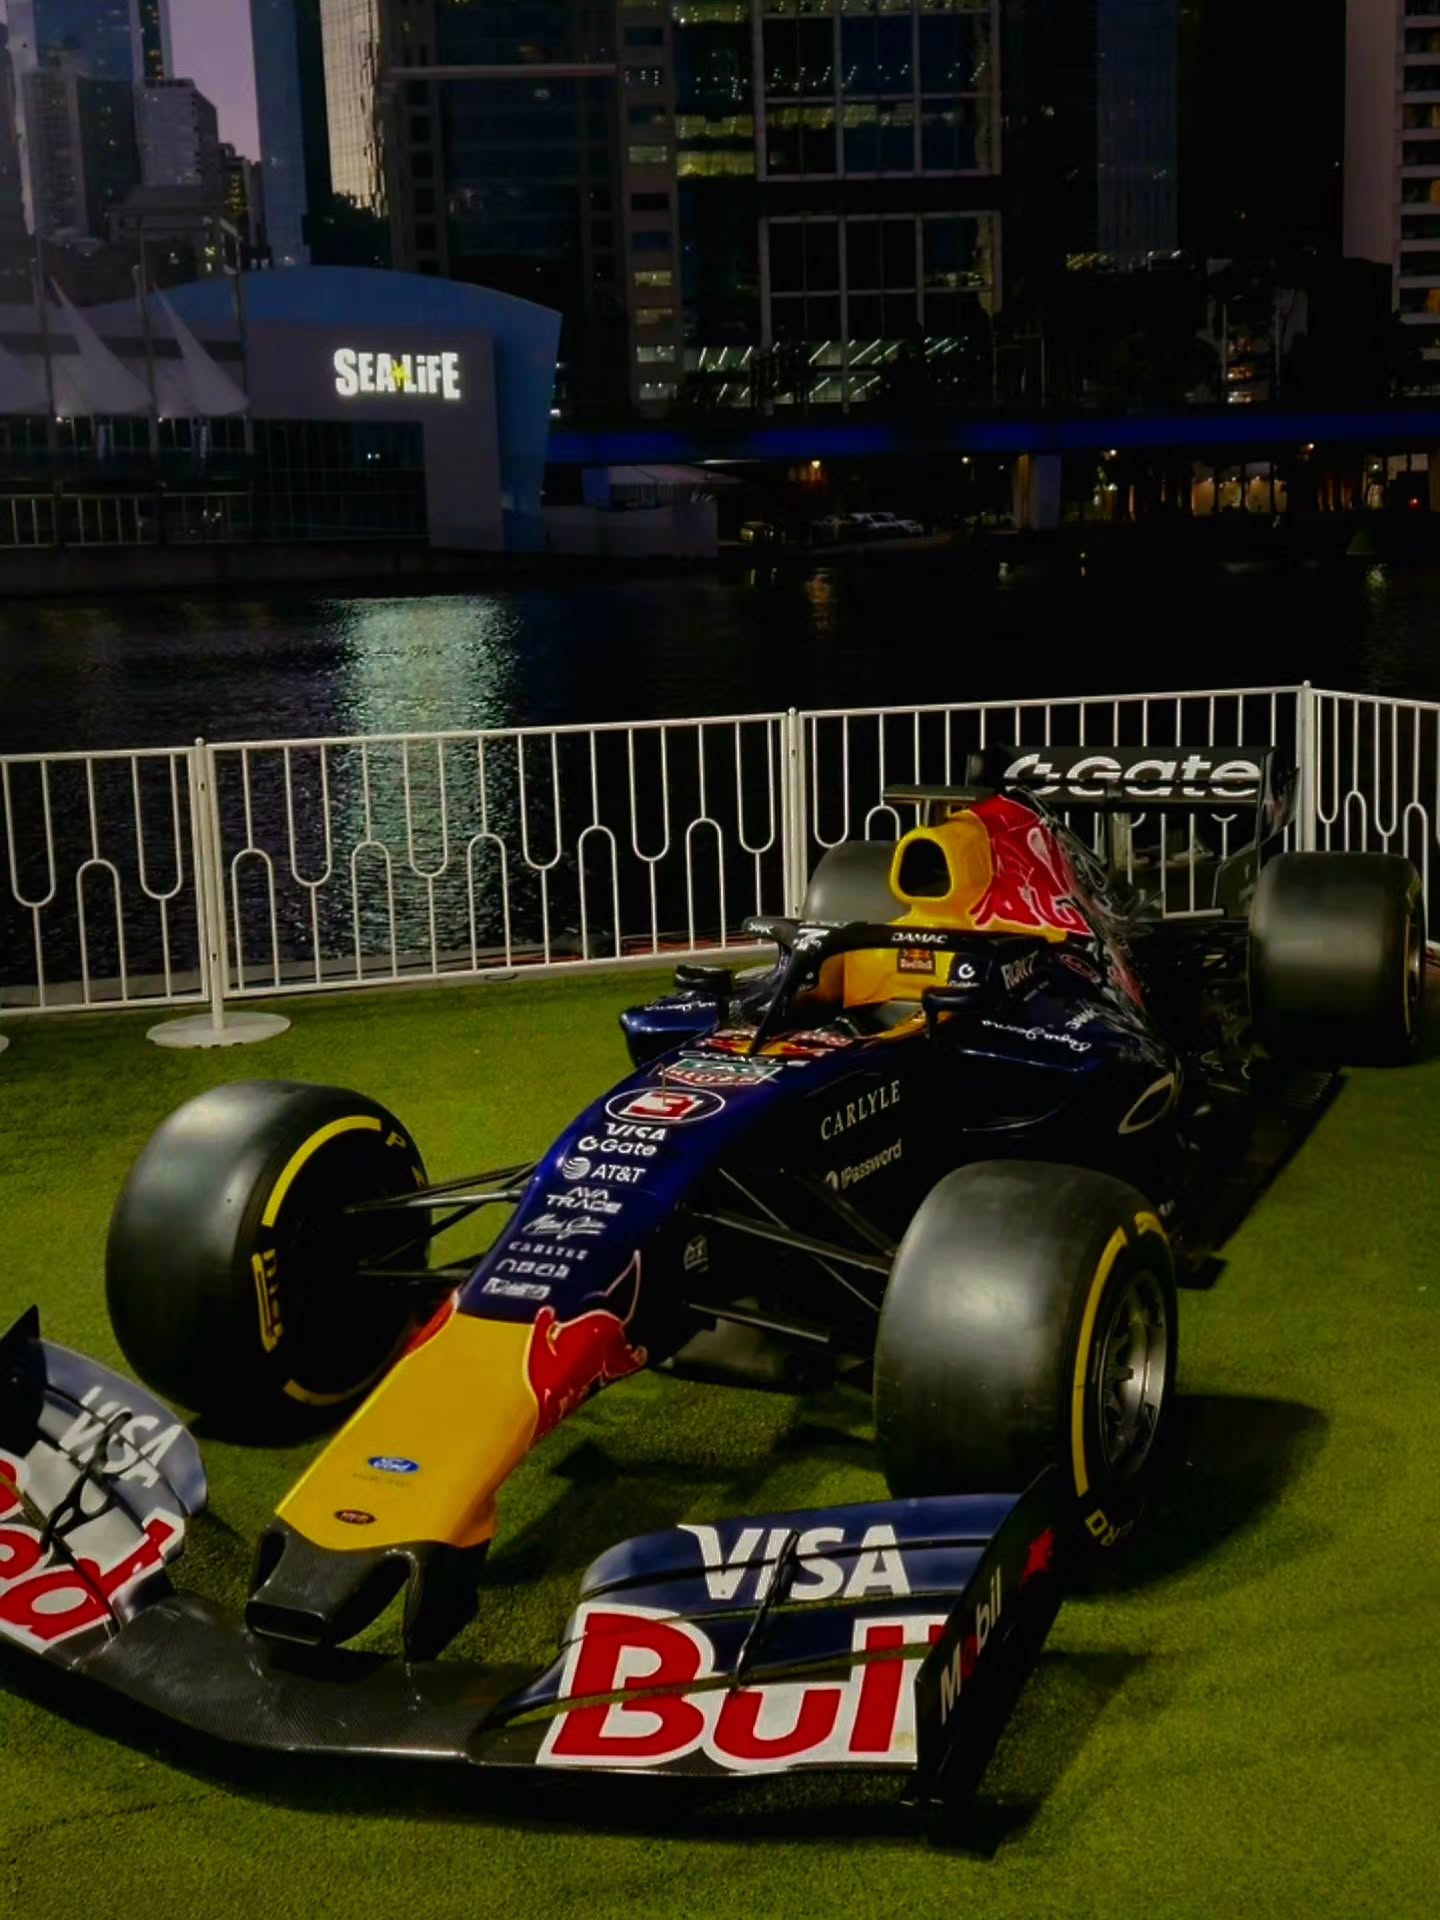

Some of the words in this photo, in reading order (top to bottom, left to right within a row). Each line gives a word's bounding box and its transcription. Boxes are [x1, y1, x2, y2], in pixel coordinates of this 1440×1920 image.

[333, 347, 397, 397] SEA
[890, 931, 949, 945] DAMAC
[820, 1079, 901, 1141] CARLYLE
[589, 1164, 647, 1184] AT&T
[677, 1524, 912, 1601] VISA
